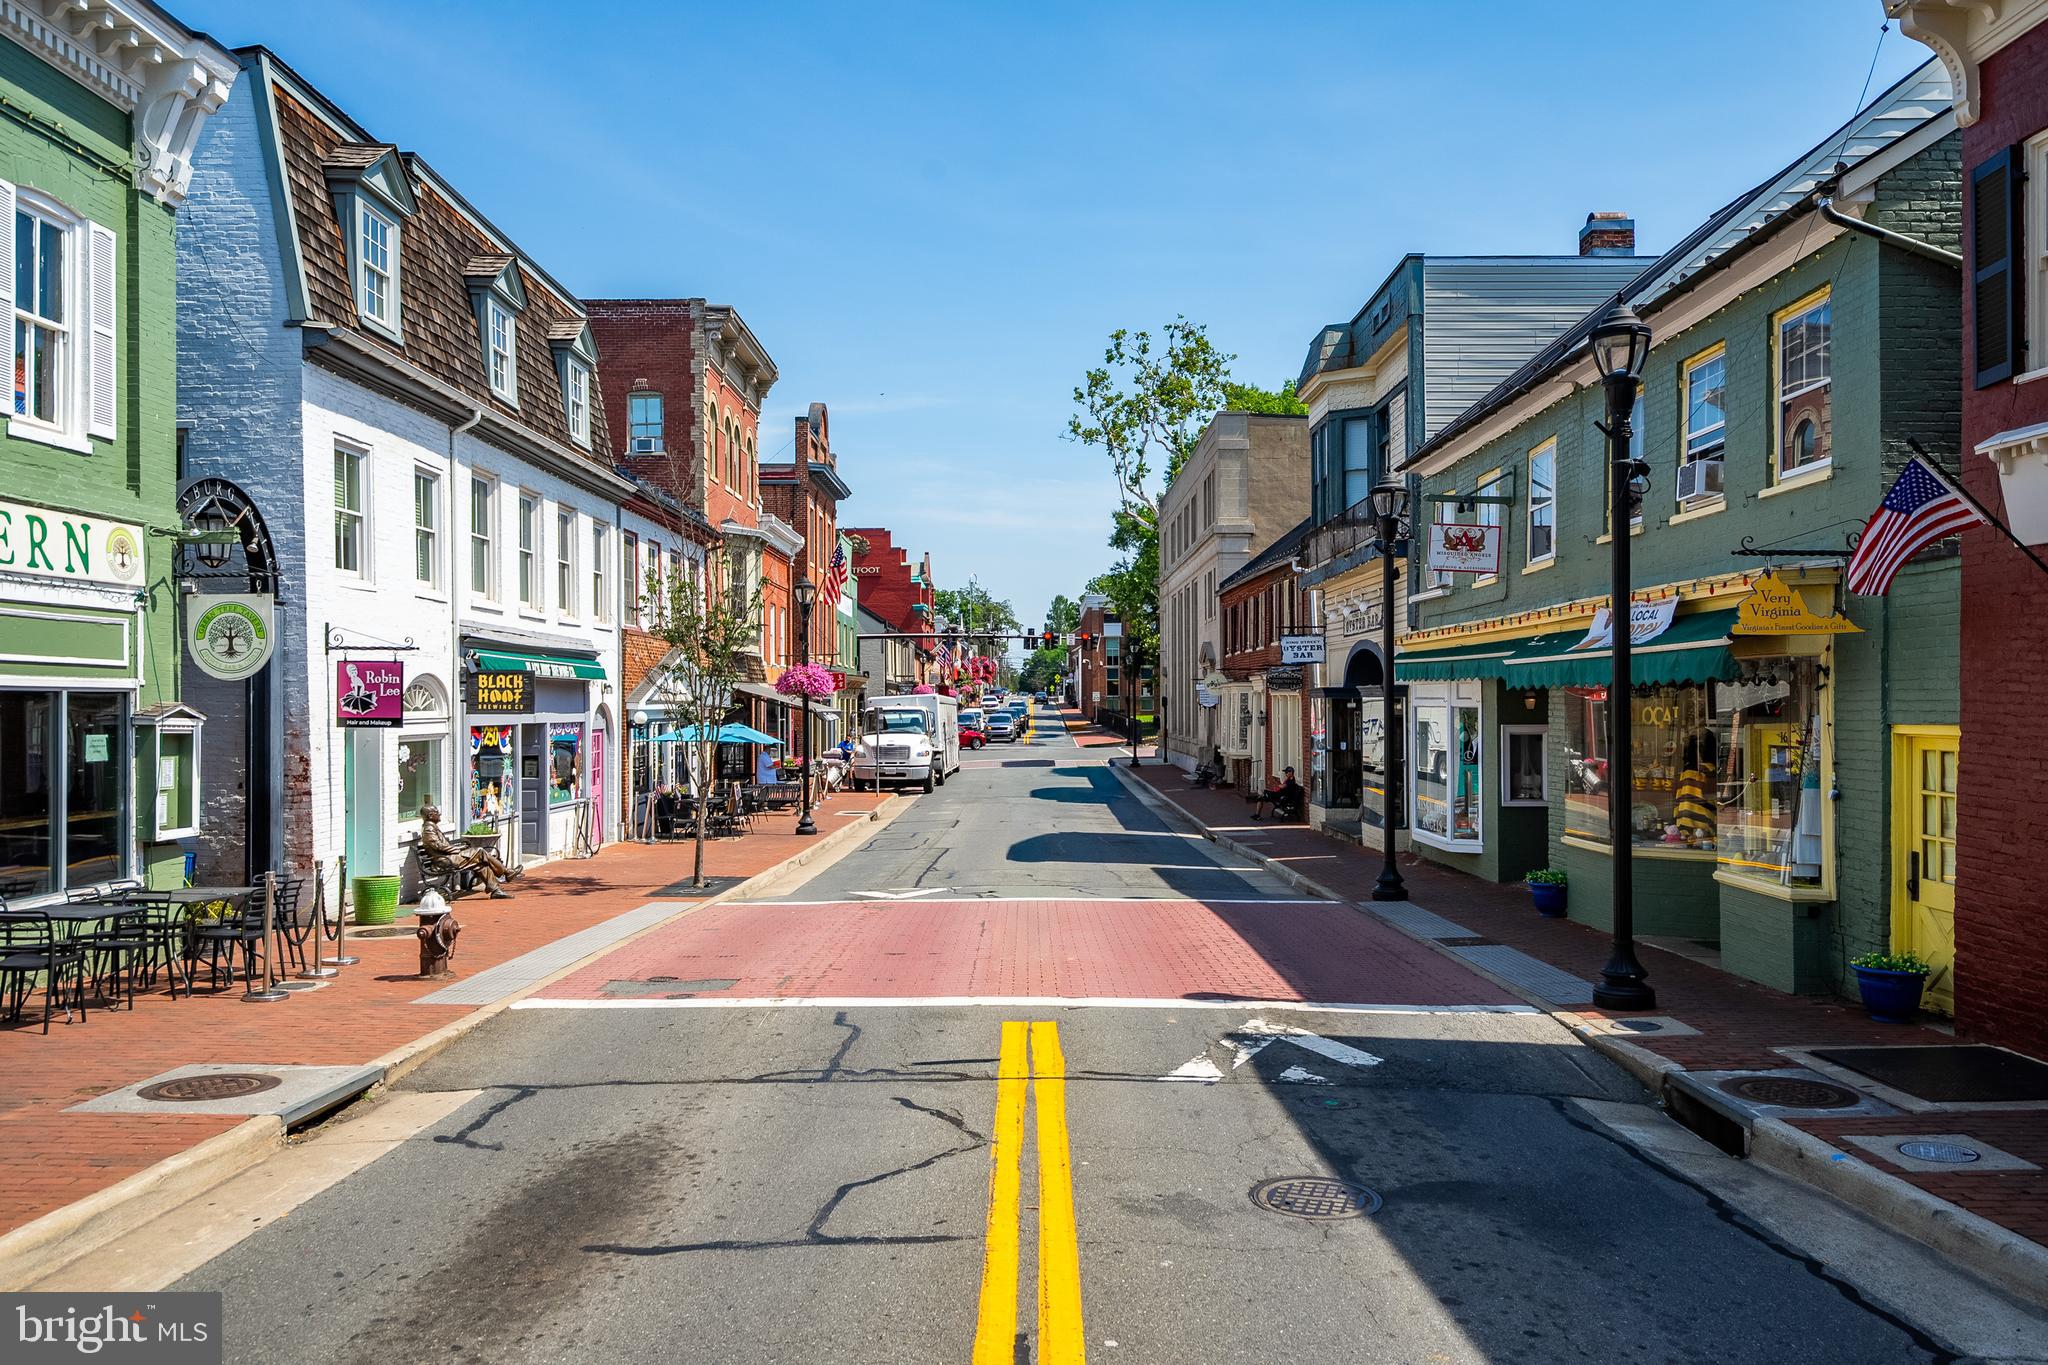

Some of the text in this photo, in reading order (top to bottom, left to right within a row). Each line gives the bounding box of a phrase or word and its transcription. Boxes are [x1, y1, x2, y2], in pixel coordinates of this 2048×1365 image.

[1761, 589, 1791, 603] Very
[1631, 609, 1660, 621] LOCAL
[1750, 603, 1801, 620] Virginia
[1775, 623, 1795, 631] Finest
[1830, 621, 1847, 630] Gifts
[365, 669, 400, 683] Robin
[478, 674, 524, 688] BLACK
[380, 683, 400, 696] Lee
